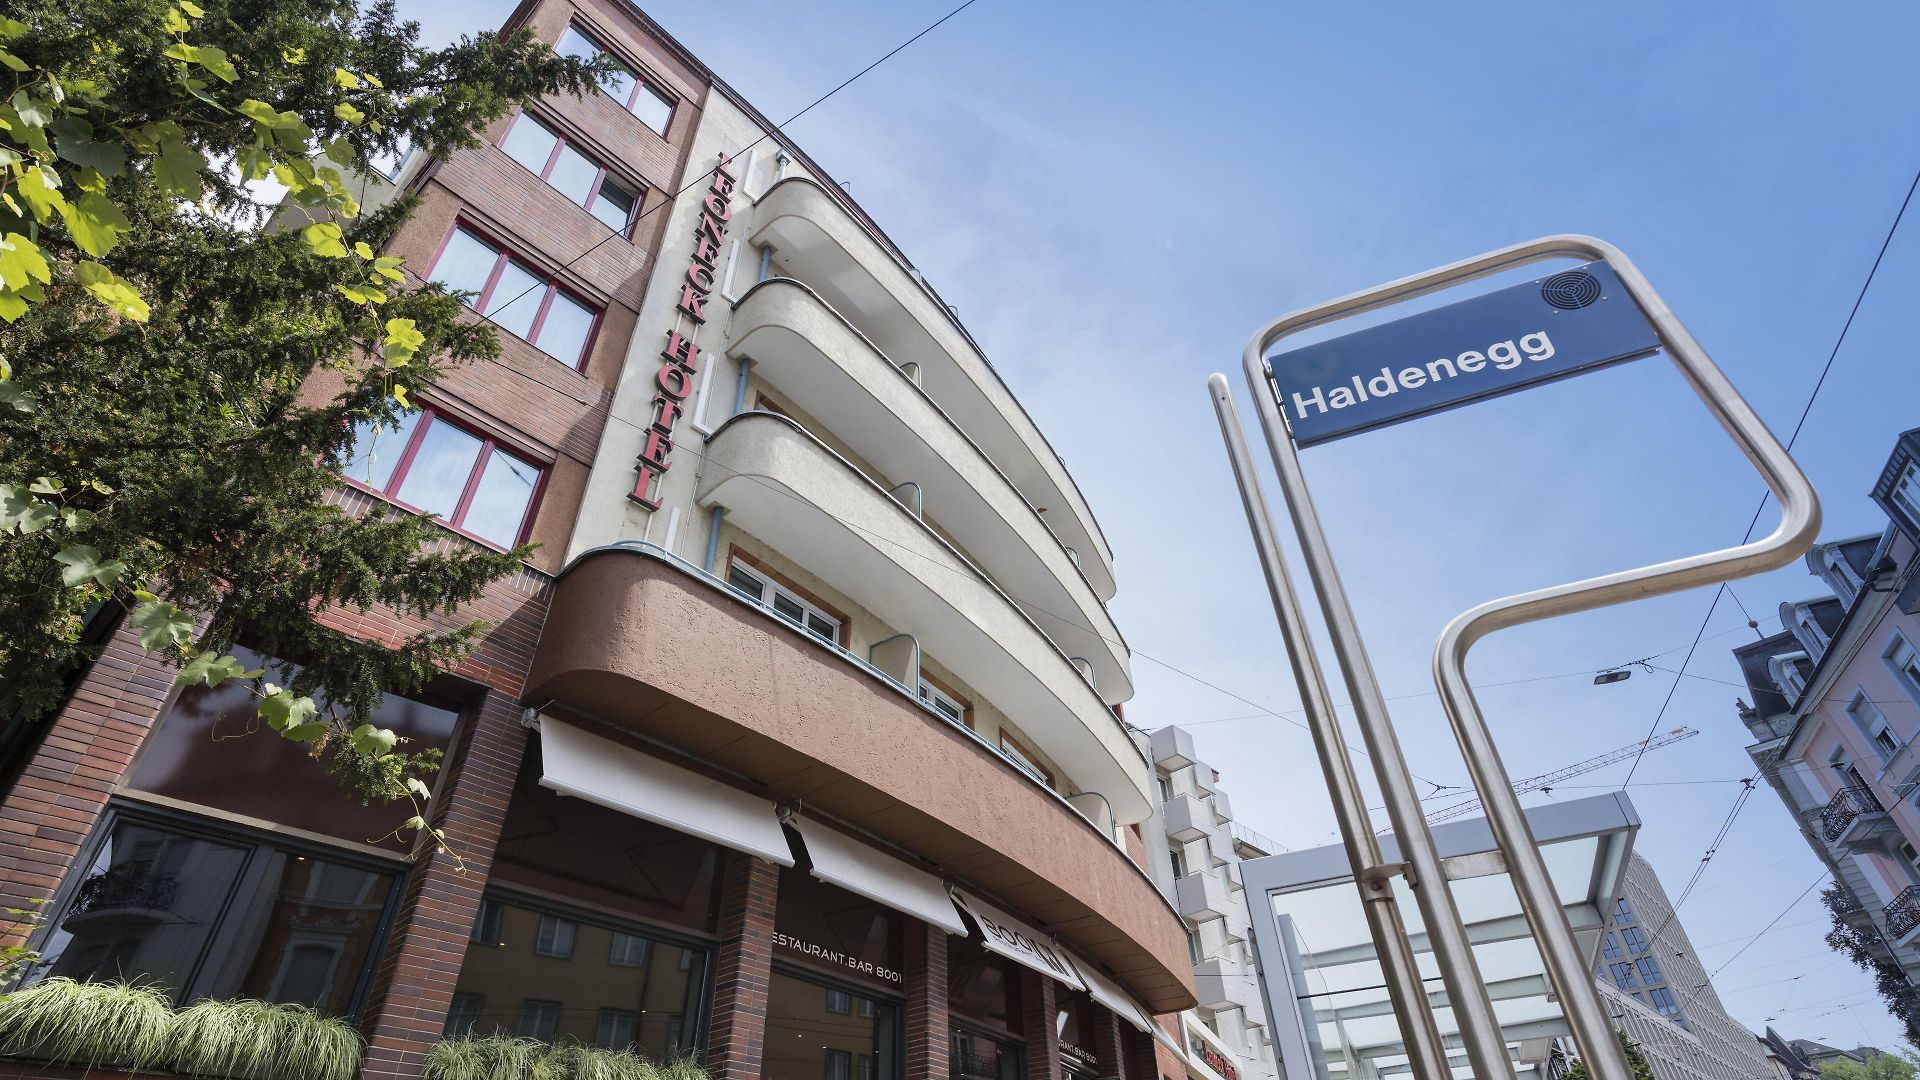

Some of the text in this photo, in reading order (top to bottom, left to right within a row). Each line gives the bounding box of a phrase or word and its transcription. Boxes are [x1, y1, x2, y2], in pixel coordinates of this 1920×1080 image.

[626, 152, 737, 512] LEONECK HOTEL
[1292, 330, 1556, 419] Haldenegg
[876, 966, 902, 983] 8001
